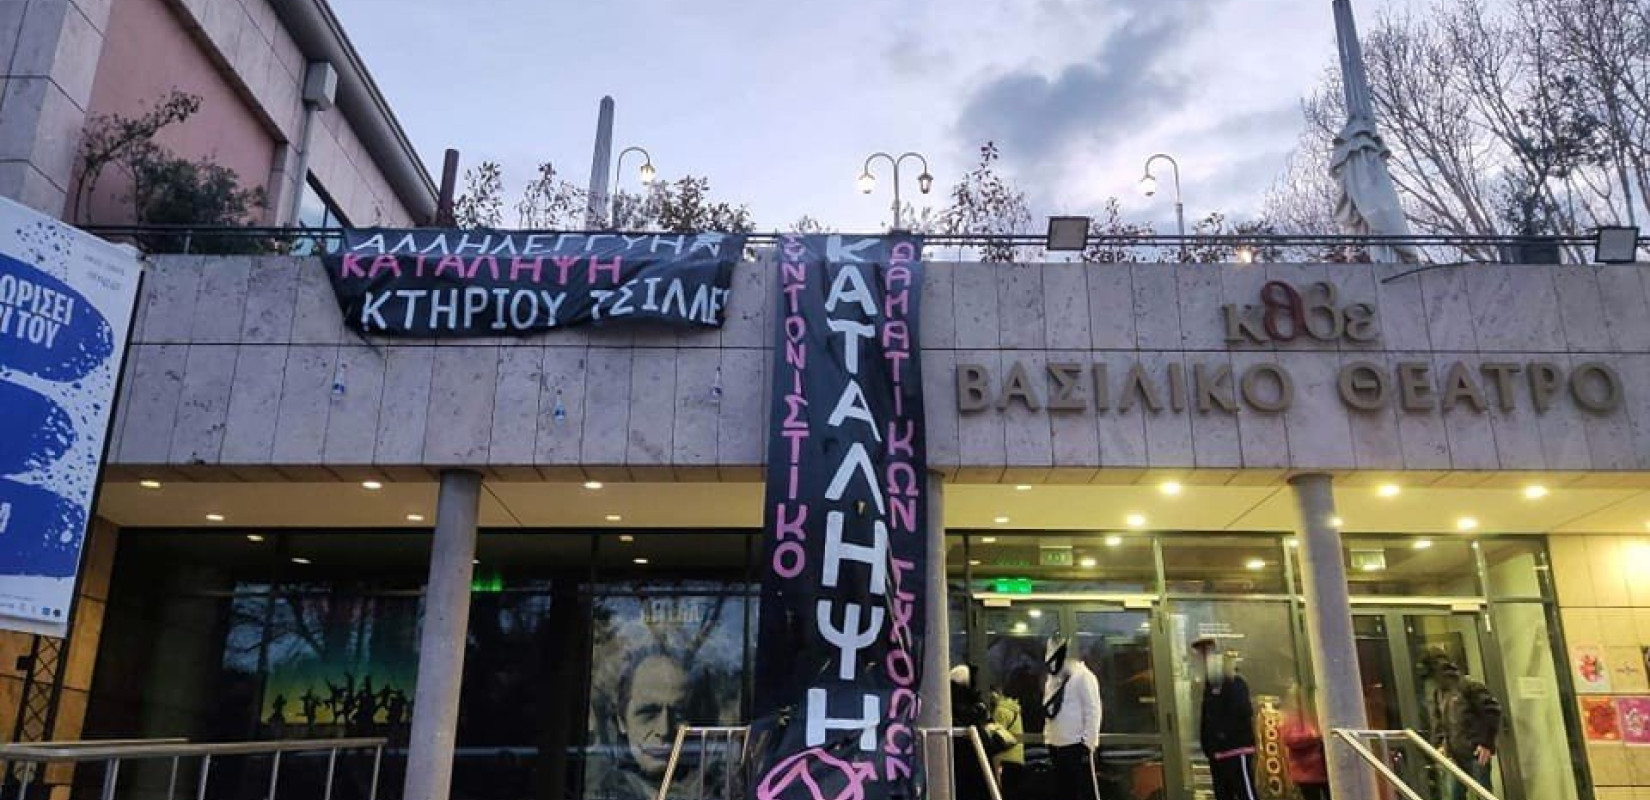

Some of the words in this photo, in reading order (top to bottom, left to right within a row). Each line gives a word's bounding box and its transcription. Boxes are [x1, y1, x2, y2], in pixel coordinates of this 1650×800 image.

[341, 253, 622, 285] ΚΑΤΑΛΗΨΗ
[17, 309, 60, 349] ΤΟΥ
[360, 286, 568, 331] ΚΤΗΡΙΟΥ
[955, 360, 1296, 416] ΒΑΣΙΛΙΚΟ
[1338, 359, 1625, 417] ΘΕΑΤΡΟ
[805, 235, 888, 751] ΚΑΤΑΛΗΨΗ
